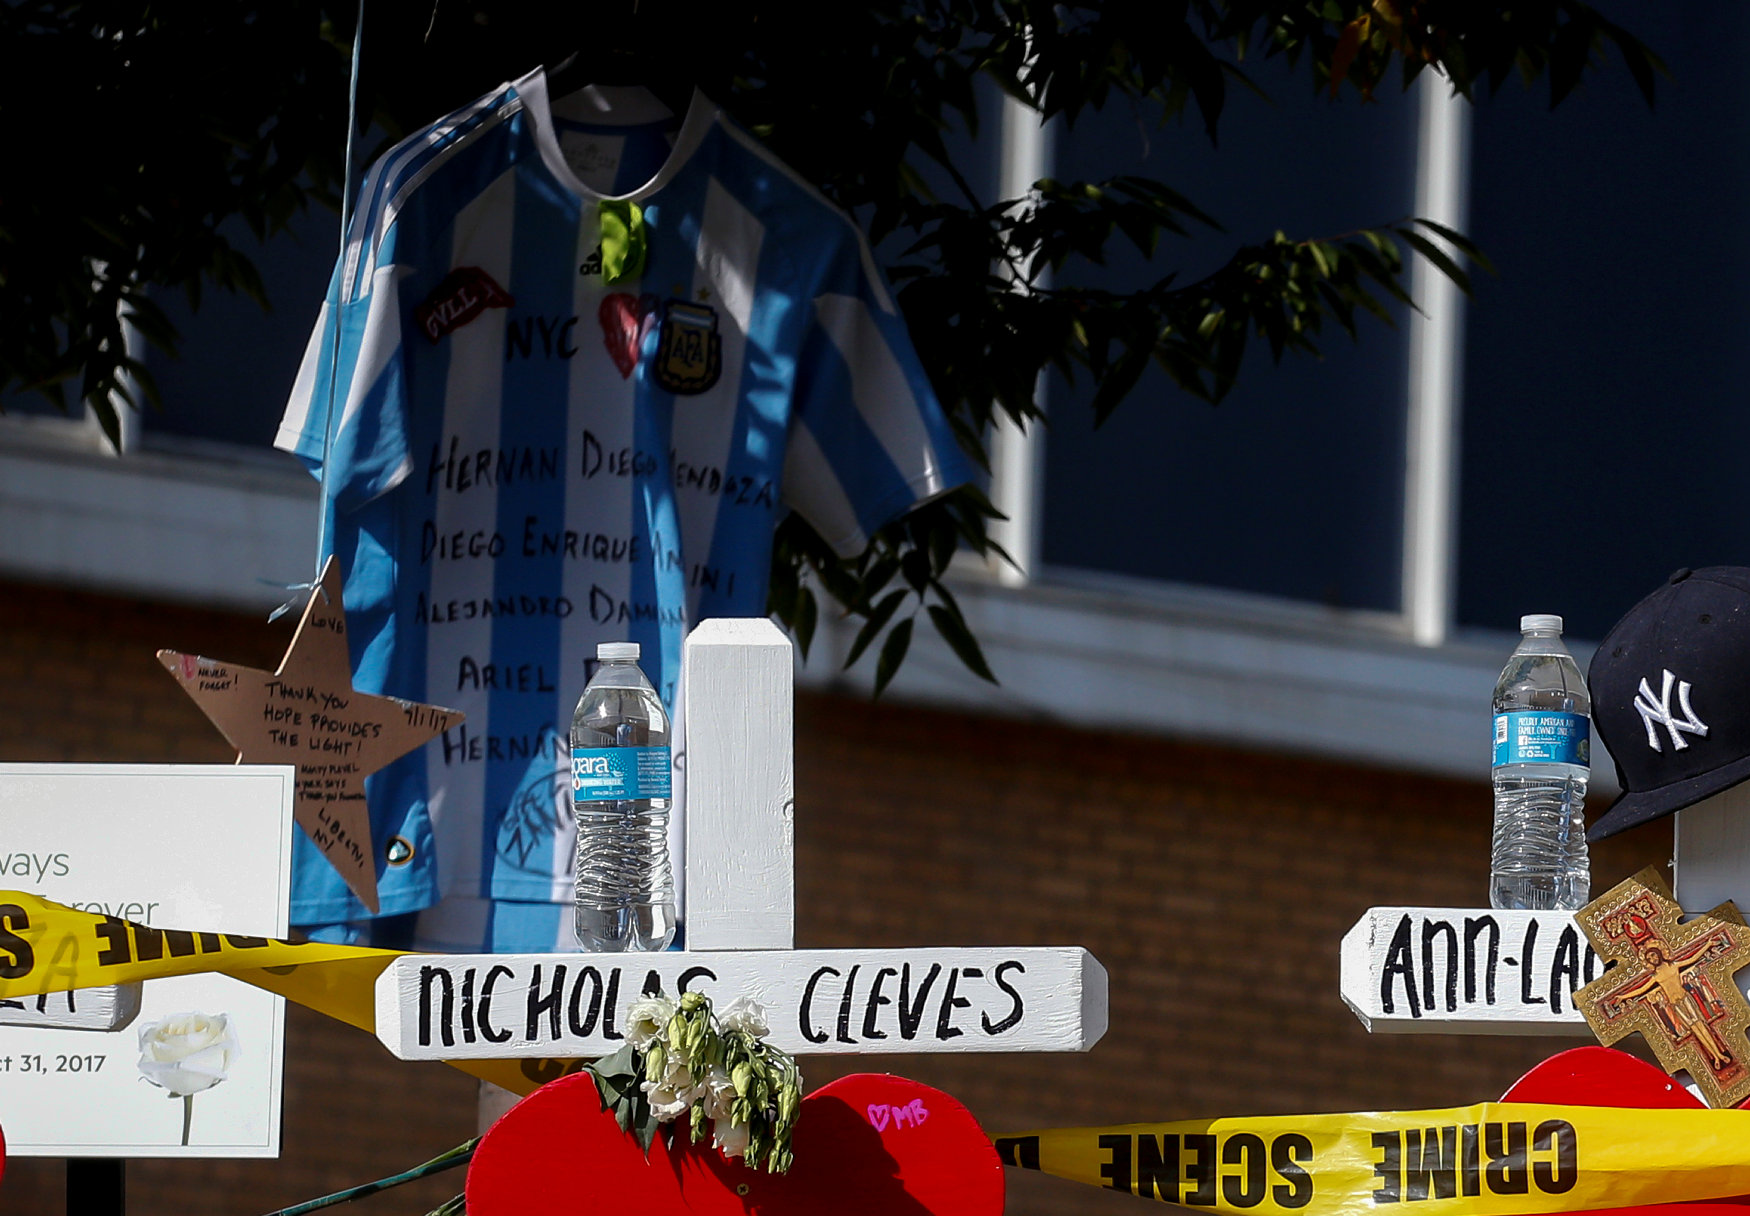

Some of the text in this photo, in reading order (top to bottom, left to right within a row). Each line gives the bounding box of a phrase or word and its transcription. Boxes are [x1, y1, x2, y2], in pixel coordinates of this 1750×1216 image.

[506, 315, 579, 361] NYC
[426, 435, 560, 493] HERNAN
[582, 430, 658, 478] DIEGO
[421, 519, 504, 565] DIEGO
[523, 515, 639, 562] ENRIQUE
[311, 613, 344, 634] LOVE
[415, 592, 573, 625] ALEJANDRO
[457, 657, 556, 693] ARIEL
[265, 681, 350, 711] THANK YOU
[263, 705, 383, 739] HOPE PROVIDES
[268, 729, 299, 747] THE
[799, 959, 1026, 1044] CLEVES
[20, 1055, 48, 1075] 31,
[55, 1054, 106, 1073] 2017
[892, 1098, 930, 1130] MB
[1098, 1132, 1314, 1209] SCENE
[1371, 1118, 1578, 1204] CRIME
